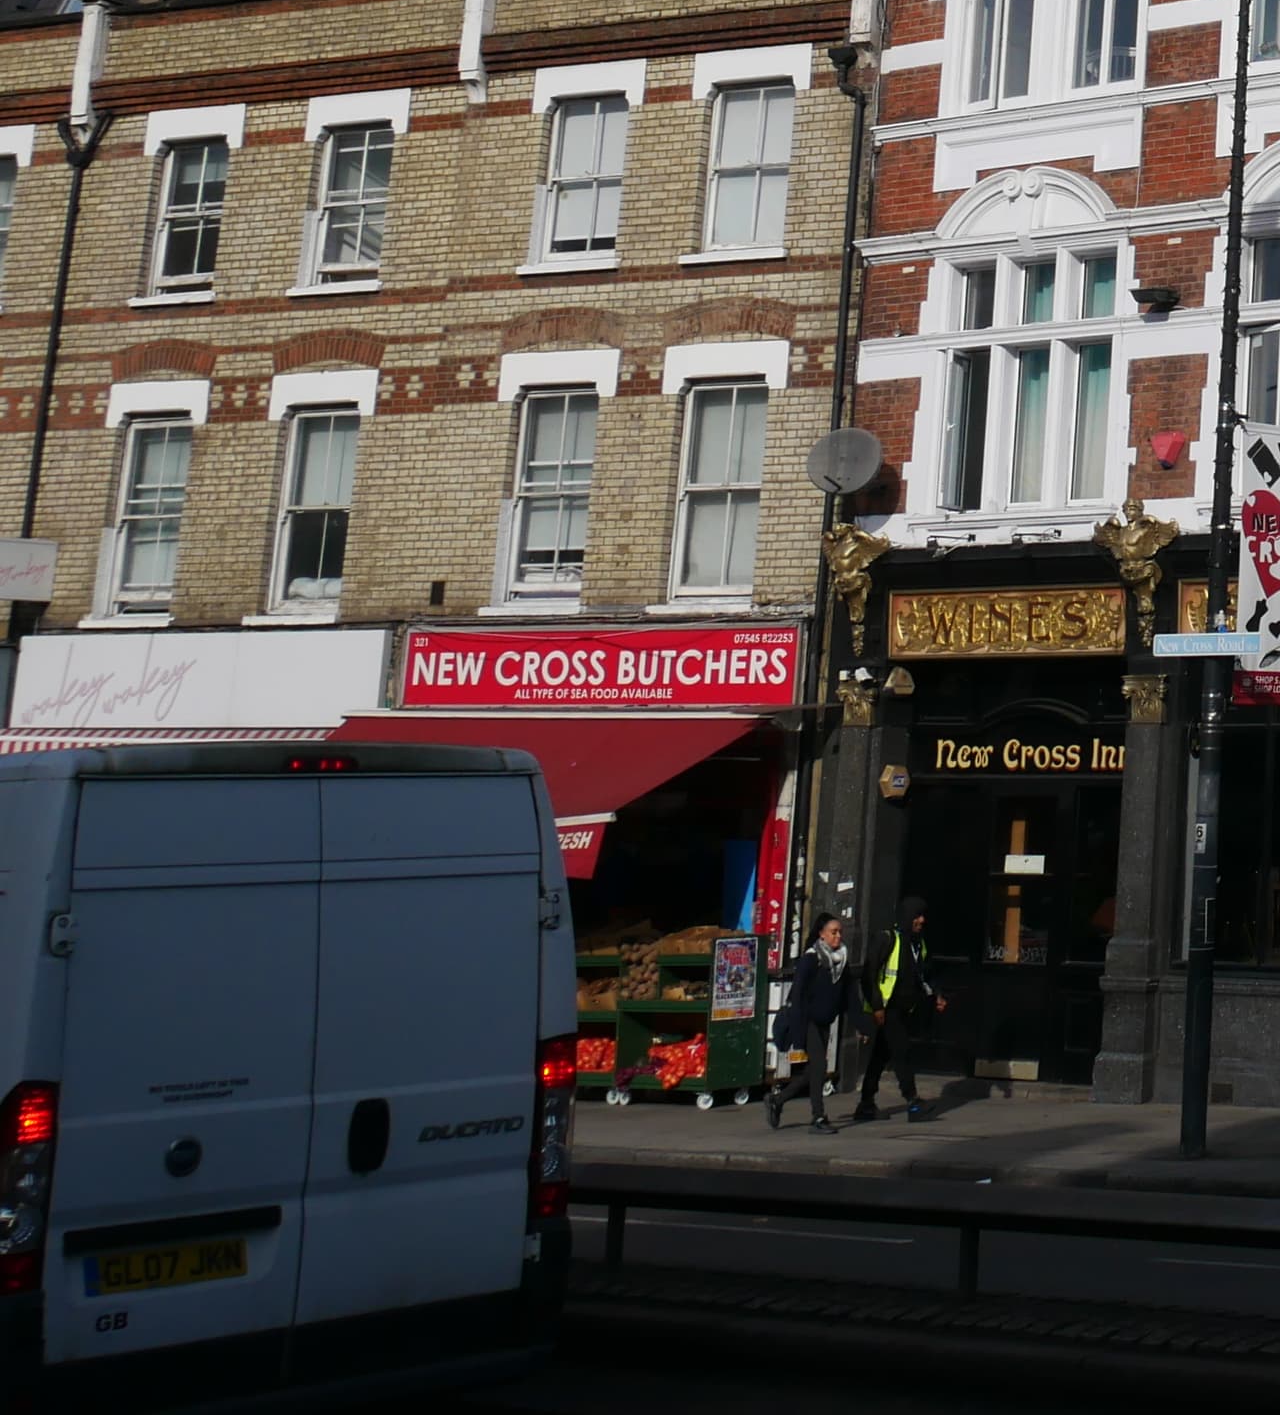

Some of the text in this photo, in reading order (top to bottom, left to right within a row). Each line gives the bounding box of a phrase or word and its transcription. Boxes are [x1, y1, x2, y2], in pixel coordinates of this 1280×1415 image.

[927, 601, 1089, 643] WINES
[415, 637, 429, 647] 321
[1157, 639, 1178, 652] New
[1184, 638, 1214, 651] Cross
[1217, 637, 1245, 651] Road
[412, 648, 788, 686] NEW CROSS BUTCHERS
[514, 688, 673, 699] ALL TYPE OF SEA FOOD AVAILABLE
[935, 738, 994, 769] New
[1002, 737, 1081, 772] Cross
[416, 1115, 525, 1143] DUCATO
[105, 1239, 242, 1287] GL07 JKN
[95, 1312, 129, 1333] GB
